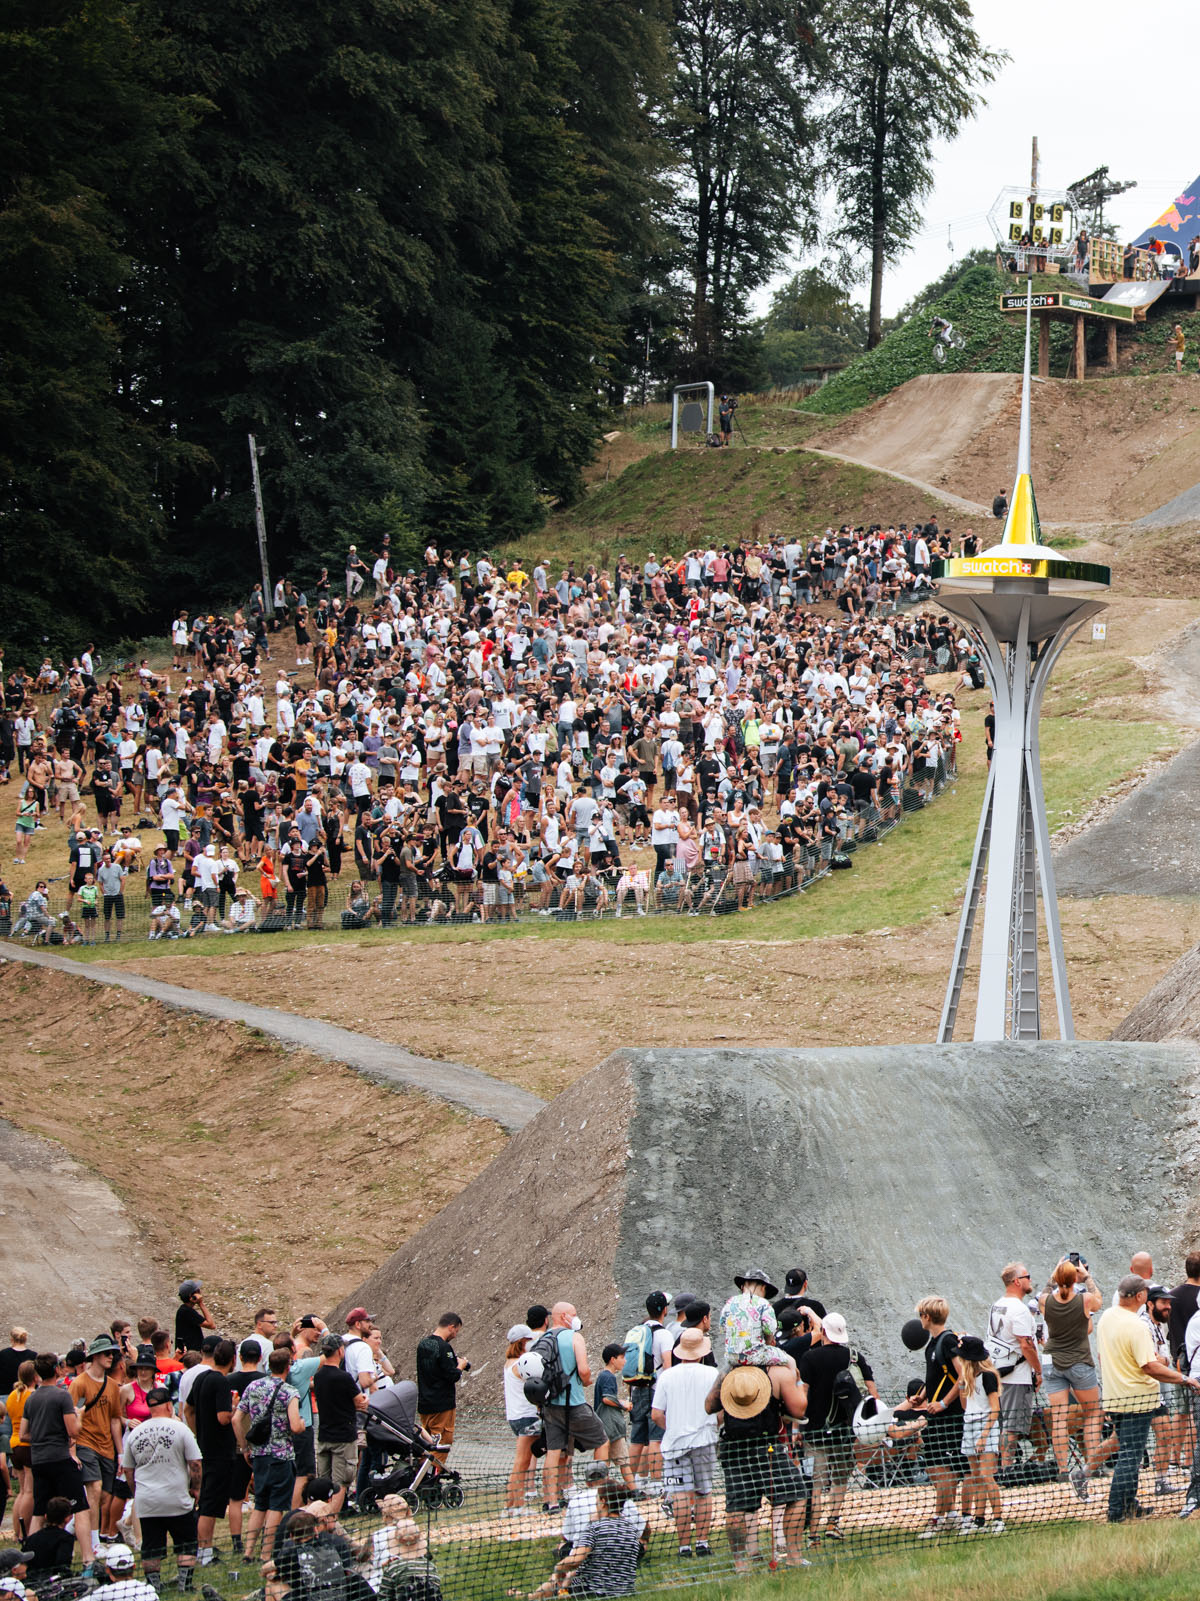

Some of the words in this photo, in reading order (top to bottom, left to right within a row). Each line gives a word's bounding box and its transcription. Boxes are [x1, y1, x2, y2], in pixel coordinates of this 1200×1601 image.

[1015, 204, 1022, 217] 9
[1035, 206, 1043, 219] 9
[1055, 208, 1063, 221] 9
[1014, 226, 1021, 239] 9
[1034, 228, 1042, 241] 9
[1054, 230, 1062, 243] 9
[1007, 296, 1047, 308] swatch
[1068, 298, 1089, 309] swatch
[962, 560, 1020, 574] swatch
